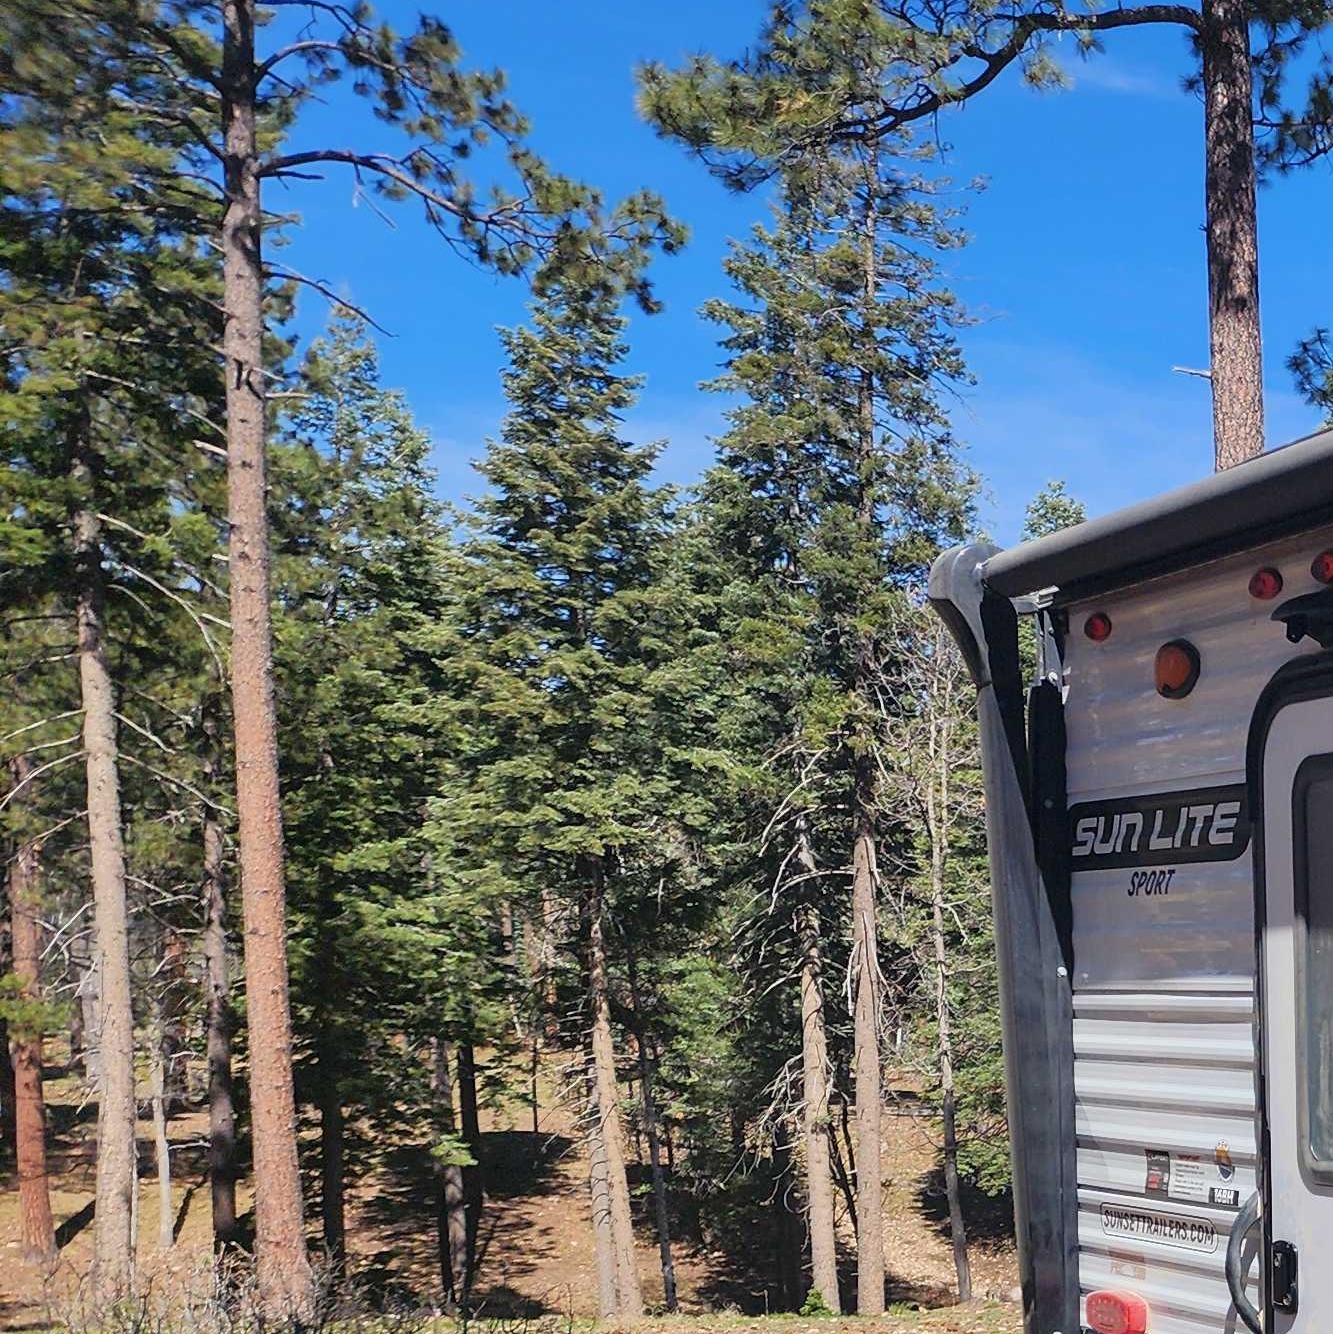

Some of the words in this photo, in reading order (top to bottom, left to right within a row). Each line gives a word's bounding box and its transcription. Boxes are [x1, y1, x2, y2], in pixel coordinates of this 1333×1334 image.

[1071, 811, 1144, 856] SUN
[1149, 801, 1241, 850] LITE
[1127, 869, 1177, 897] SPORT
[1103, 1209, 1215, 1246] SUNSETTRAILERS.COM
